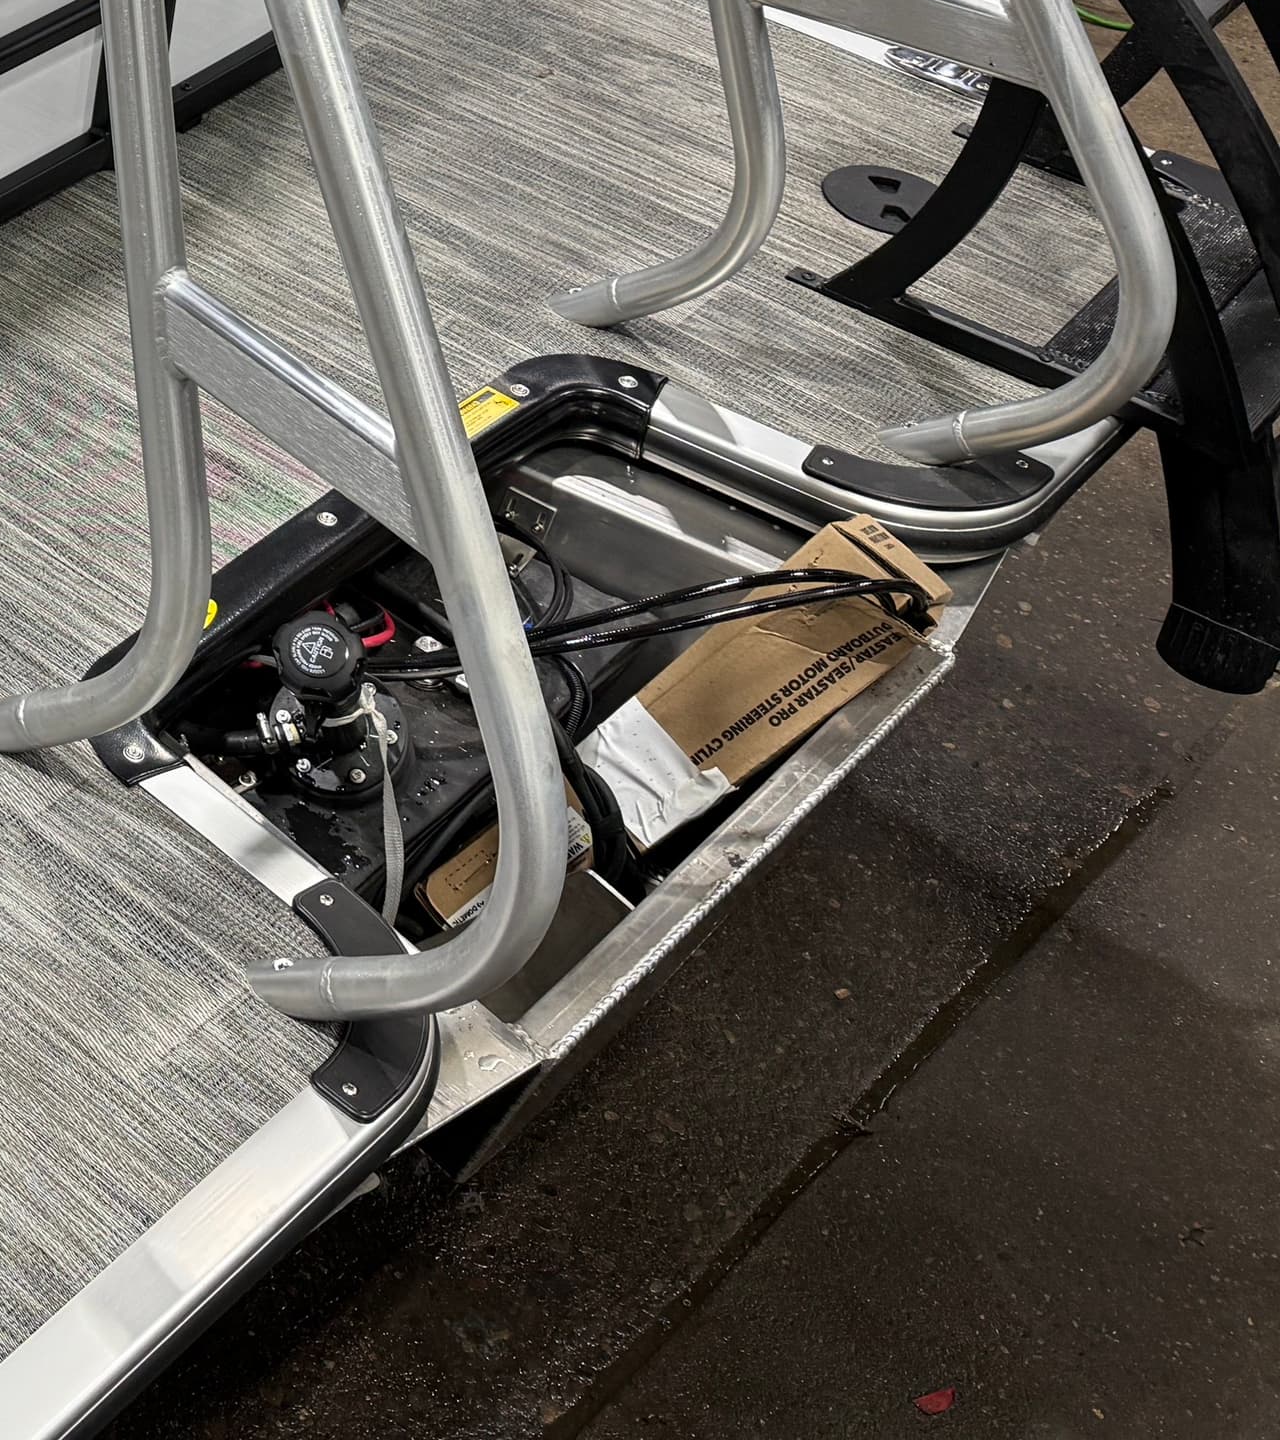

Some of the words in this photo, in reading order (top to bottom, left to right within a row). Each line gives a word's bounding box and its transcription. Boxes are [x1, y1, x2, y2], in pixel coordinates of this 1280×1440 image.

[826, 621, 894, 662] OUTBOARD
[787, 657, 829, 693] MOTOR
[721, 688, 783, 742] STEERING
[768, 703, 801, 727] PRO
